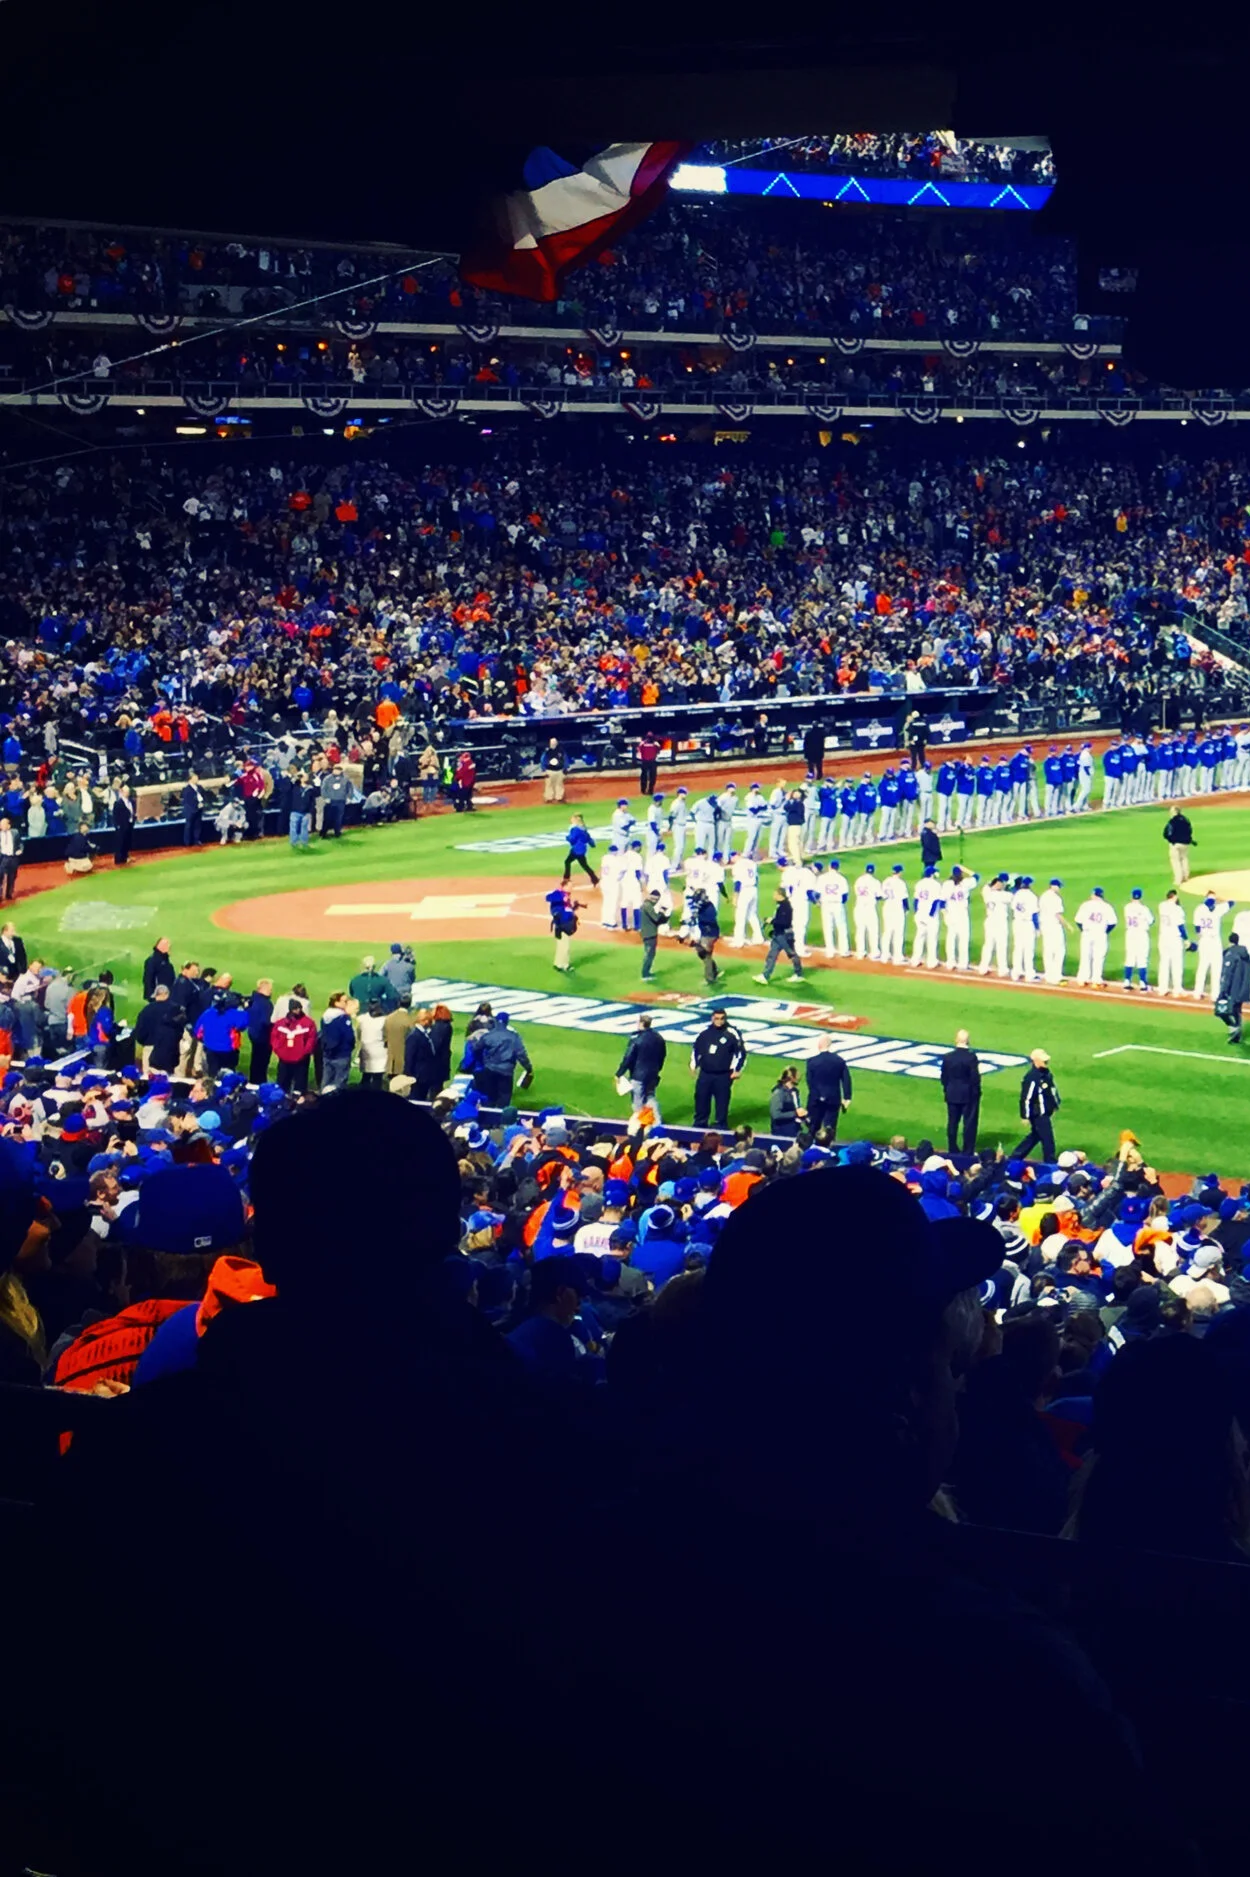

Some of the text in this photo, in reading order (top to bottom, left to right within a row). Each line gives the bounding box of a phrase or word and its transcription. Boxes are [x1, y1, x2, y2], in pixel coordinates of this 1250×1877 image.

[825, 884, 839, 895] 62
[1089, 912, 1102, 924] 40
[1199, 918, 1213, 929] 32
[411, 978, 699, 1034] WORLD
